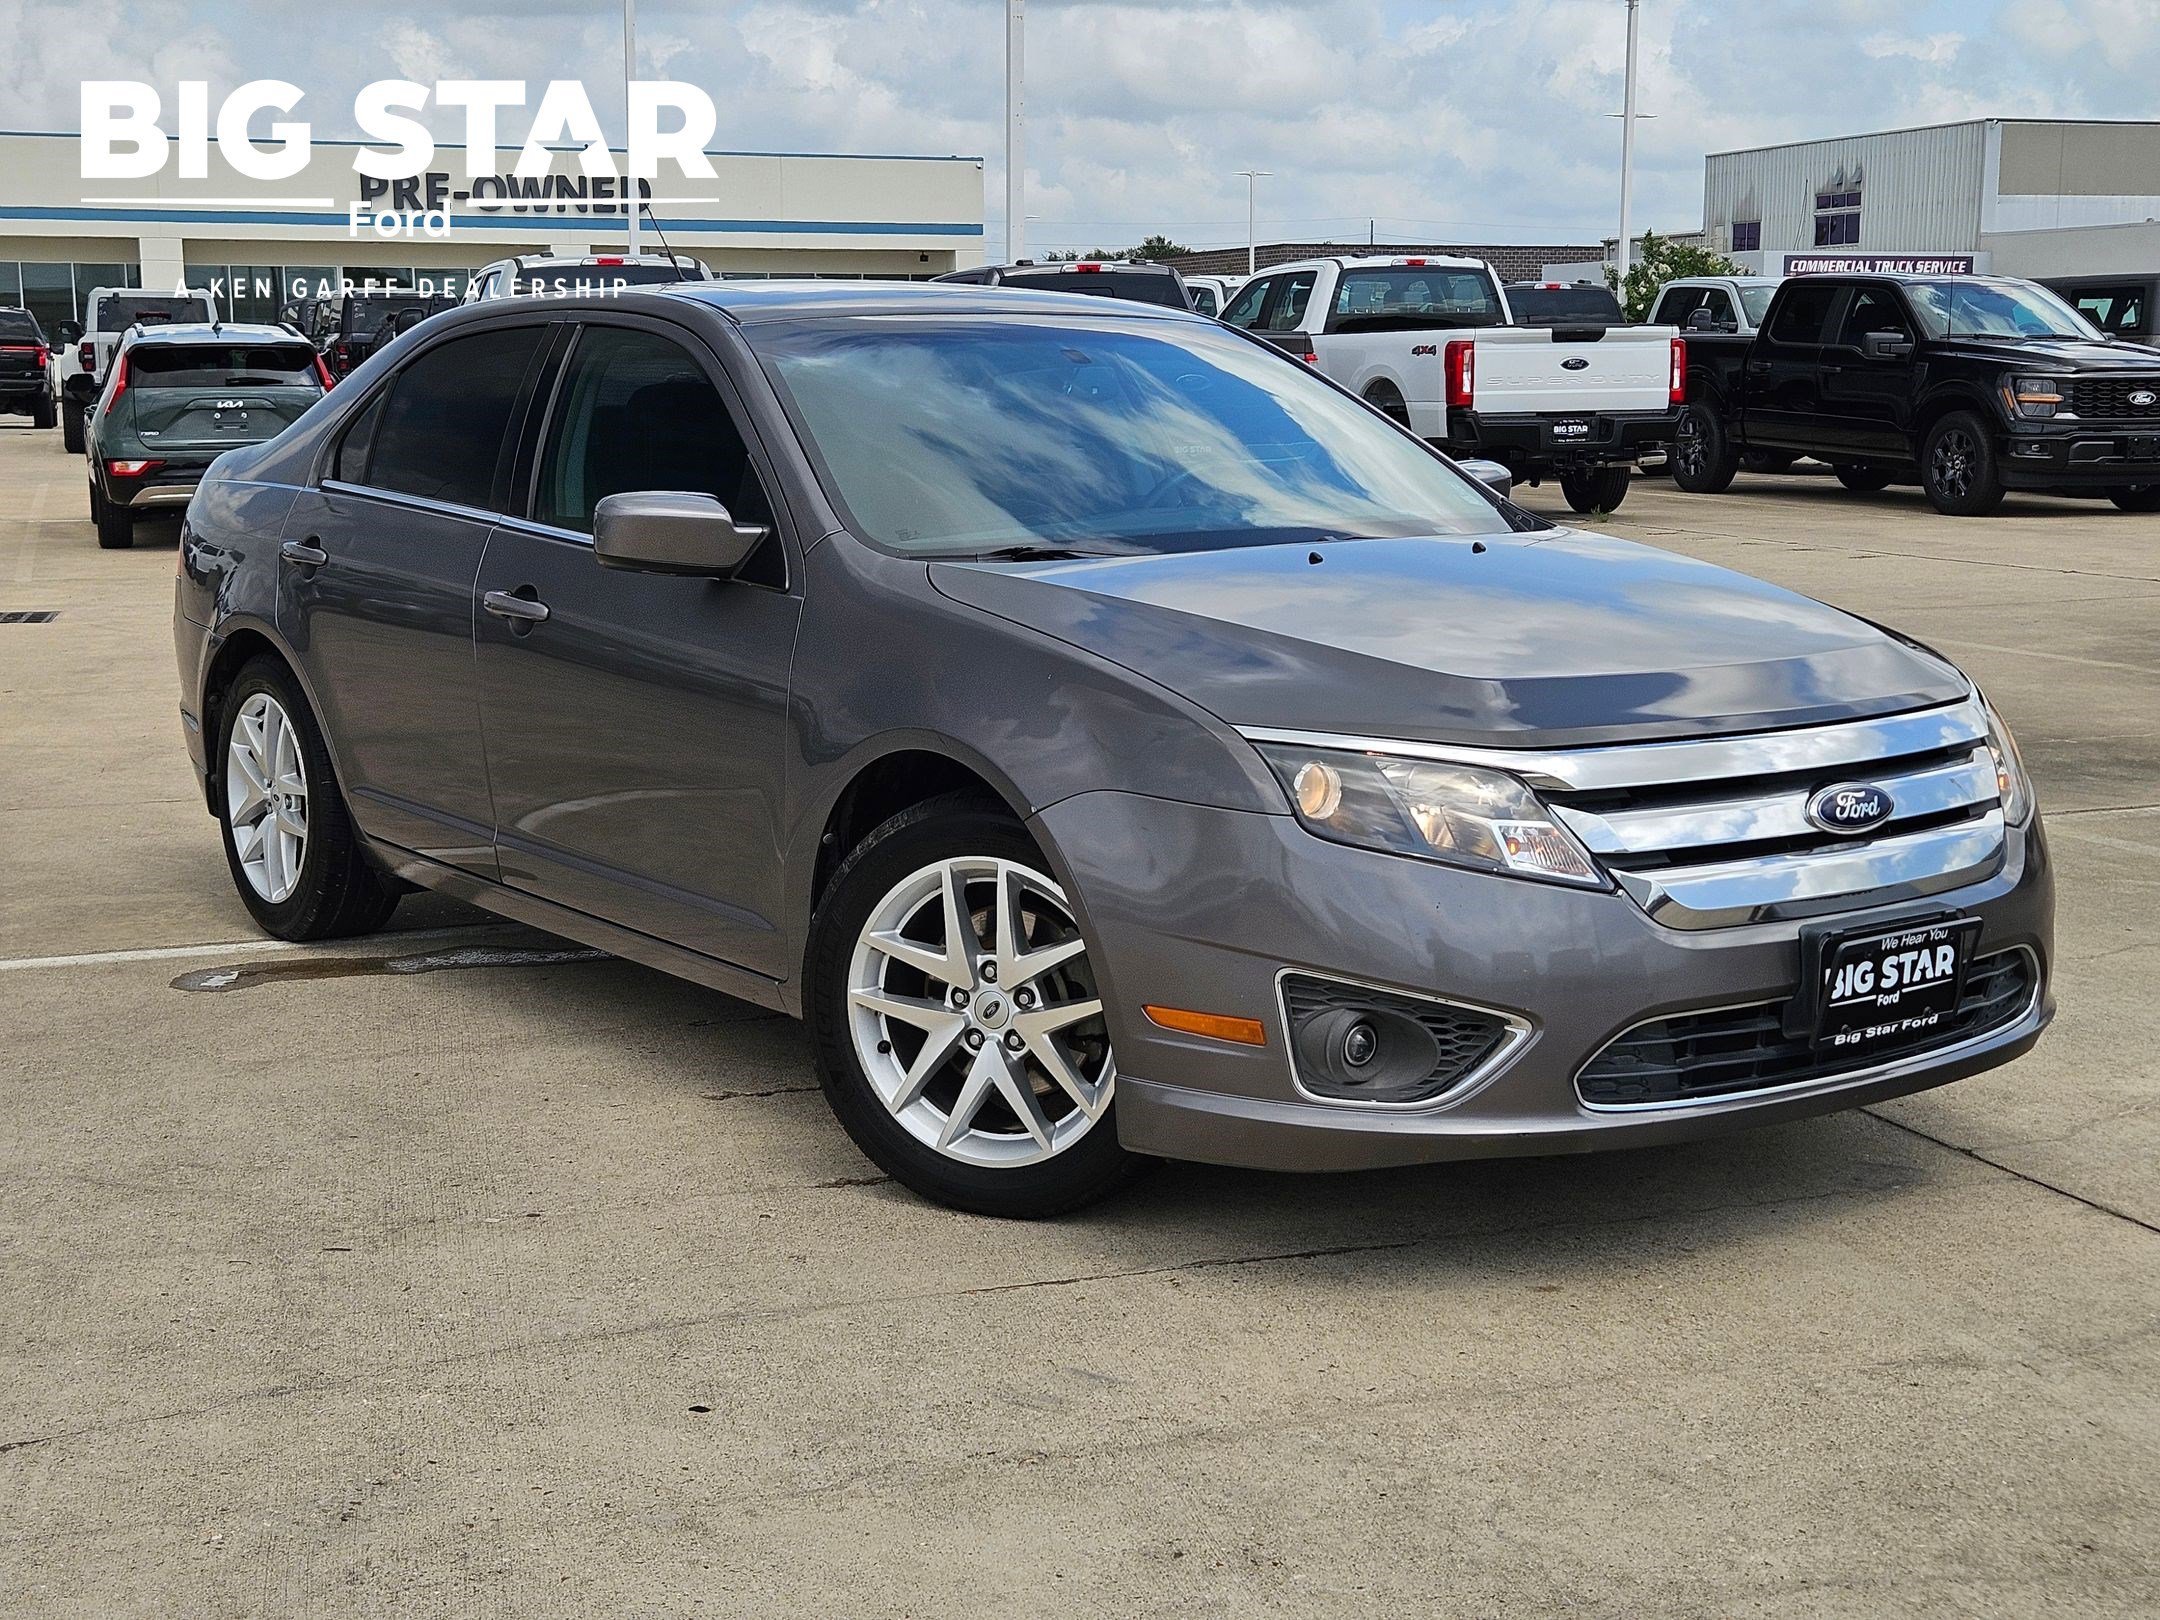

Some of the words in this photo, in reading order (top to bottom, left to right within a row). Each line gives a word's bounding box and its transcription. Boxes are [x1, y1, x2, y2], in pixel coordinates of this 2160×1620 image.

[359, 172, 652, 214] PRE-OWNED
[1790, 260, 1872, 272] COMMERCIAL
[1874, 260, 1915, 273] TRUCK
[1915, 261, 1967, 273] SERVICE
[1486, 375, 1583, 386] SUPER
[1589, 374, 1660, 385] DUTY
[1567, 425, 1589, 433] STAR
[1834, 791, 1882, 820] Ford
[1881, 937, 1899, 951] We
[1900, 932, 1928, 947] Hear
[1929, 928, 1949, 941] You
[1880, 944, 1955, 989] STAR
[1877, 990, 1900, 1007] Ford
[1834, 1032, 1862, 1046] Big
[1865, 1023, 1899, 1039] Star
[1901, 1014, 1939, 1031] Ford
